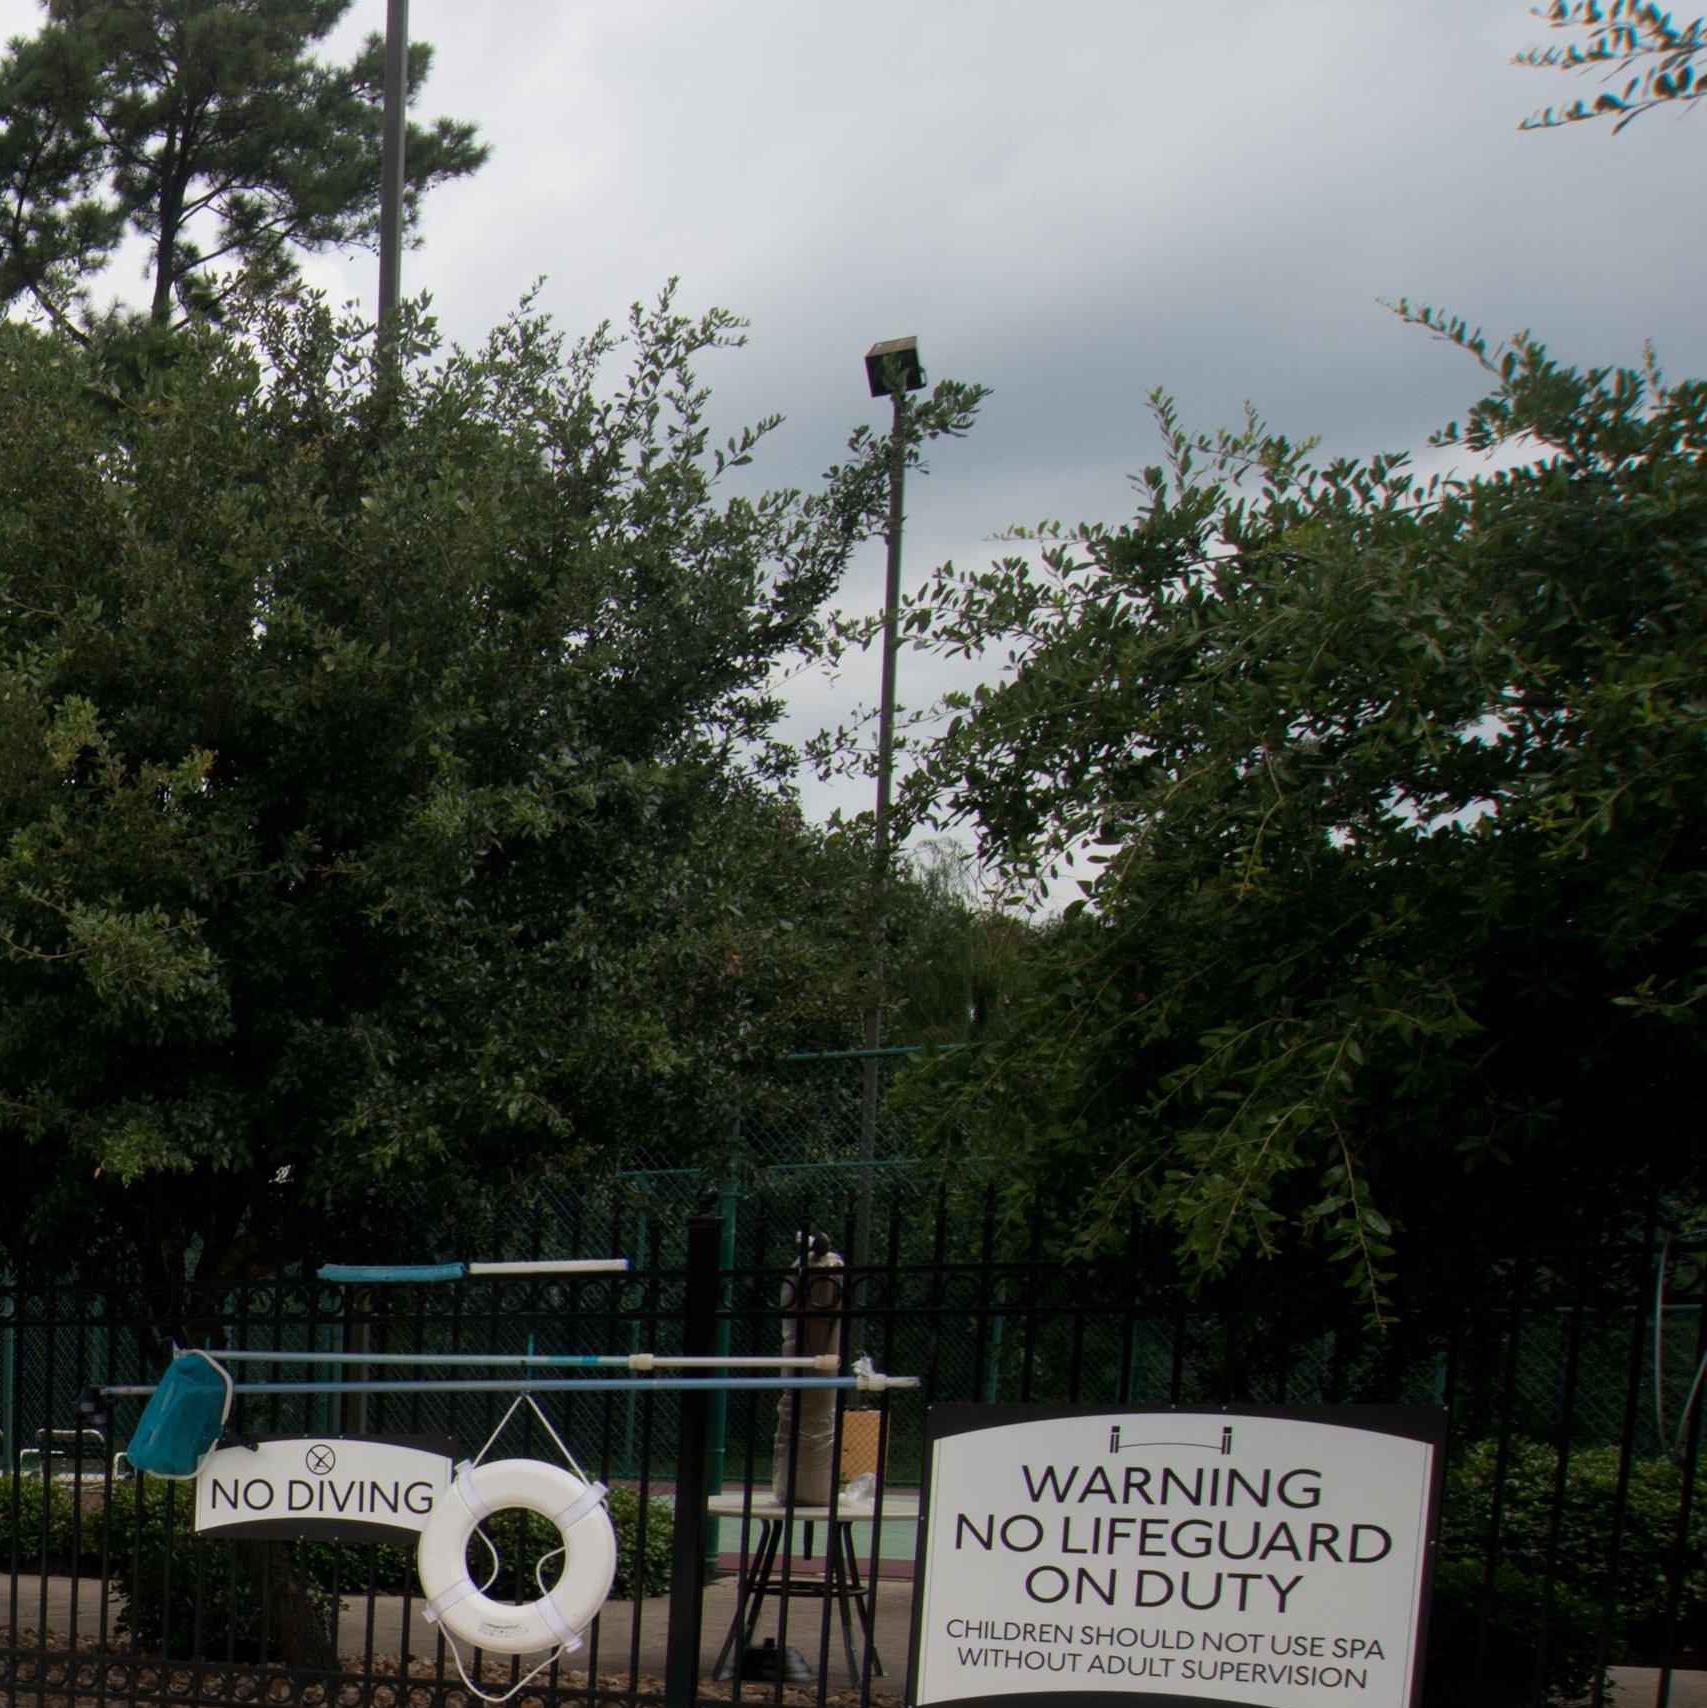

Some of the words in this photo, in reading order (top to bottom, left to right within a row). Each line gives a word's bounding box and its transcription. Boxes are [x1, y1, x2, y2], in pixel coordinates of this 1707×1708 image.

[211, 1478, 274, 1511] NO
[288, 1479, 434, 1515] DIVING
[1021, 1464, 1322, 1510] WARNING
[954, 1513, 1044, 1553] NO
[1061, 1515, 1392, 1564] LIFEGUARD
[1025, 1565, 1117, 1606] ON
[1134, 1569, 1305, 1614] DUTY
[946, 1618, 1073, 1644] CHILDREN
[1080, 1625, 1195, 1651] SHOULD
[1202, 1631, 1265, 1656] NOT
[1271, 1634, 1325, 1658] USE
[1332, 1637, 1386, 1661] SPA
[957, 1647, 1083, 1673] WITHOUT
[1087, 1654, 1176, 1679] ADULT
[1181, 1660, 1368, 1690] SUPERVISION
